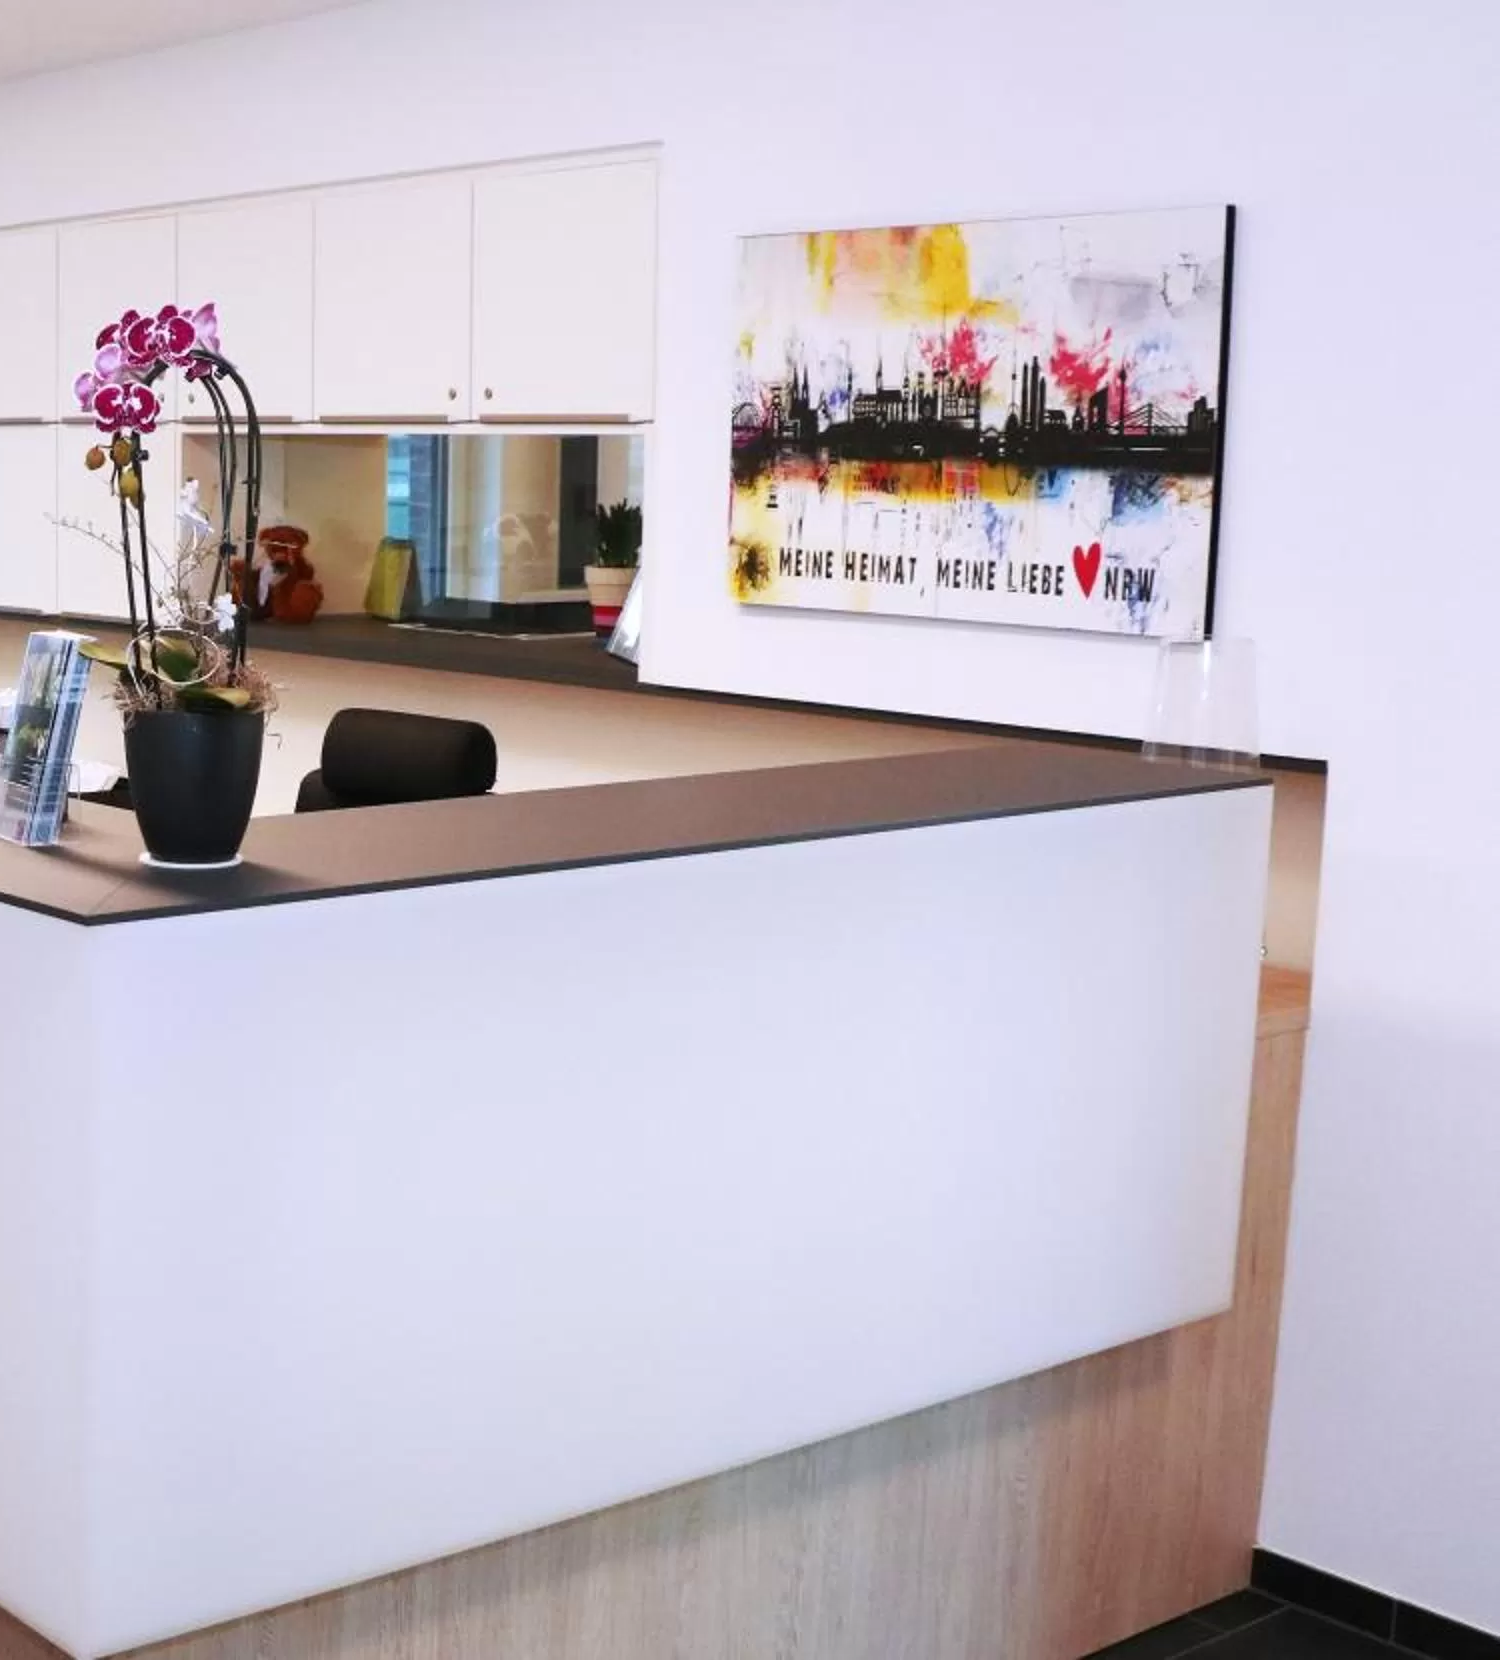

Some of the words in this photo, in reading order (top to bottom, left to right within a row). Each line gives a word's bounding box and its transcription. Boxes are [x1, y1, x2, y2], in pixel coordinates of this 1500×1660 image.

[779, 547, 834, 579] MEINE
[936, 558, 996, 591] MEINE
[1007, 561, 1065, 596] LIEBE
[1104, 566, 1155, 602] NRW
